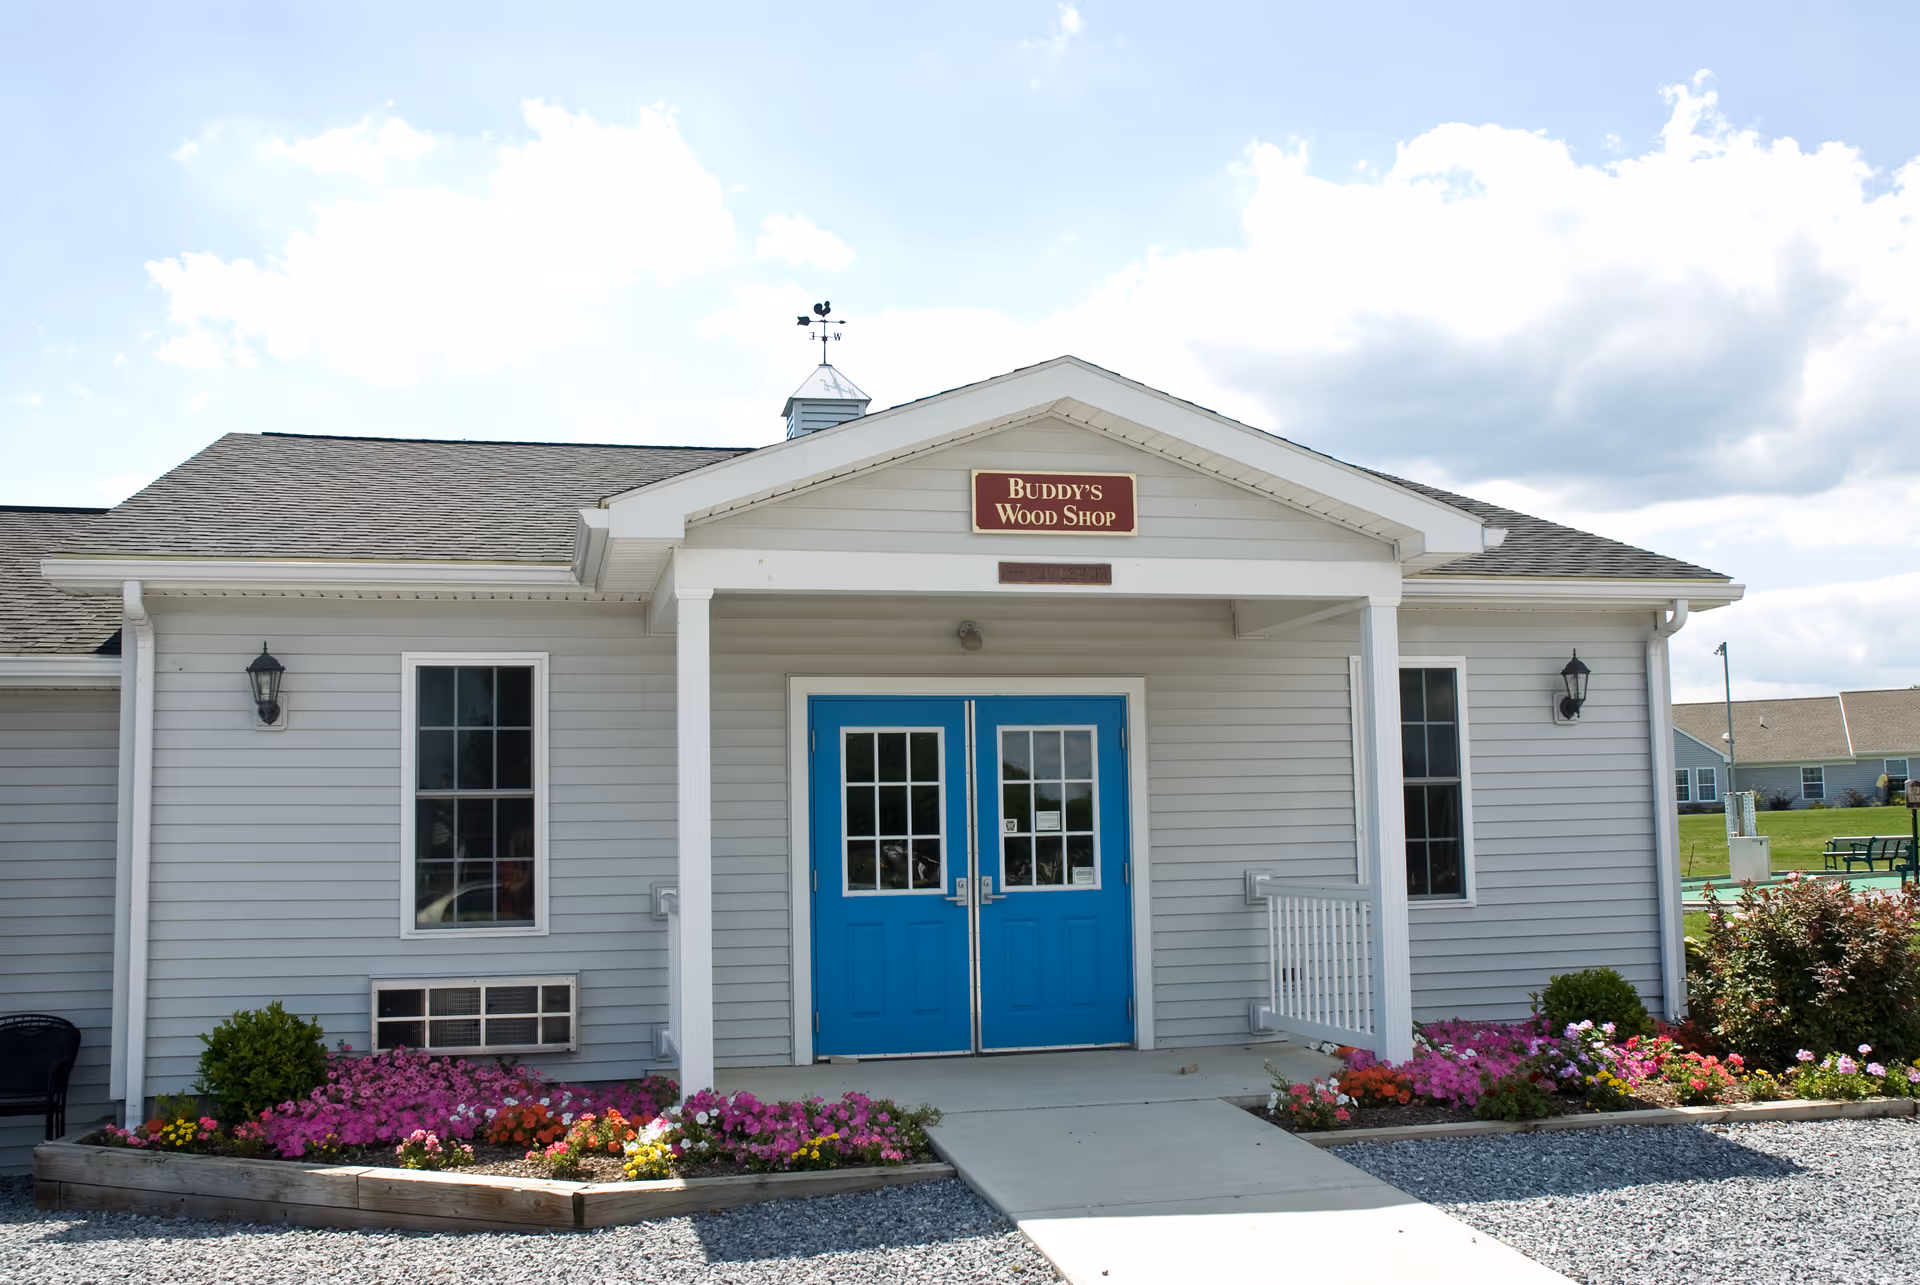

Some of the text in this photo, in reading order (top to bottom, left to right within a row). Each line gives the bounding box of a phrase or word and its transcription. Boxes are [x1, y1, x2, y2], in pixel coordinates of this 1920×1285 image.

[834, 332, 842, 341] W
[1008, 478, 1103, 500] BUDDY'S
[995, 503, 1116, 527] WOOD SHOP
